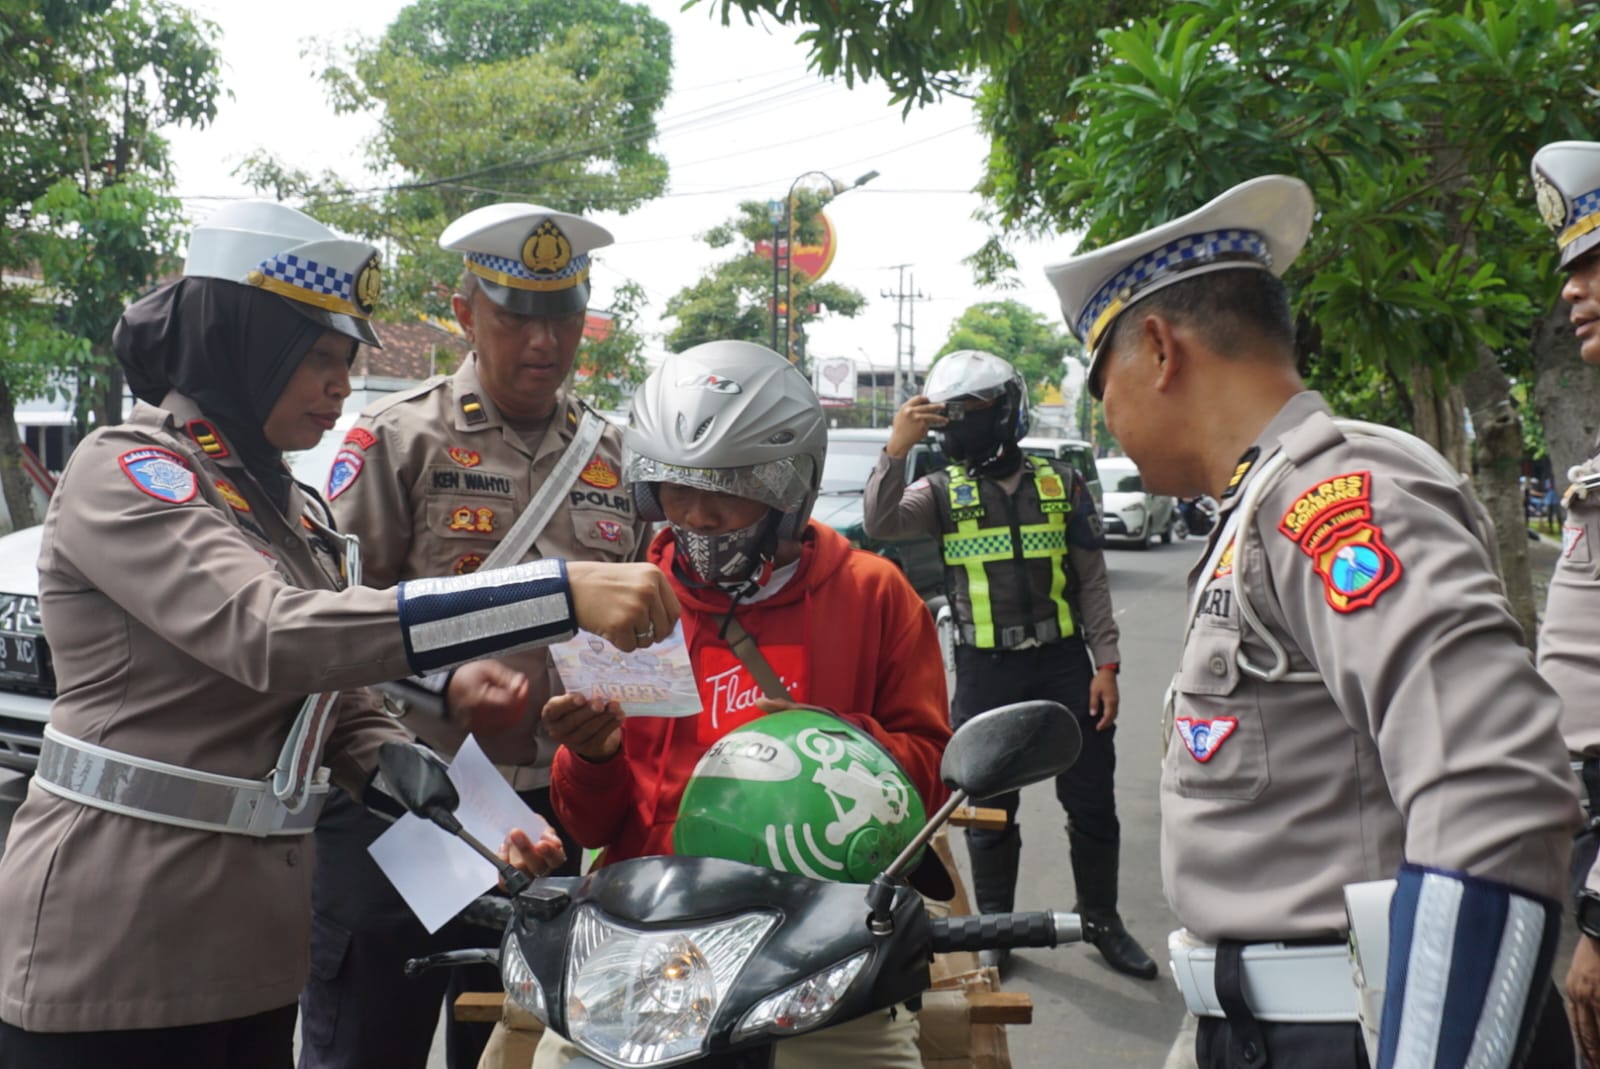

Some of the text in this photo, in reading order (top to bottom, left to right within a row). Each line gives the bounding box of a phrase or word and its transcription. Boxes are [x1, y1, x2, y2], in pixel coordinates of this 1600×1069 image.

[432, 470, 510, 494] KEN WAHYU
[570, 490, 631, 513] POLRI
[1285, 475, 1363, 529] POLRES
[1197, 588, 1231, 618] LRI
